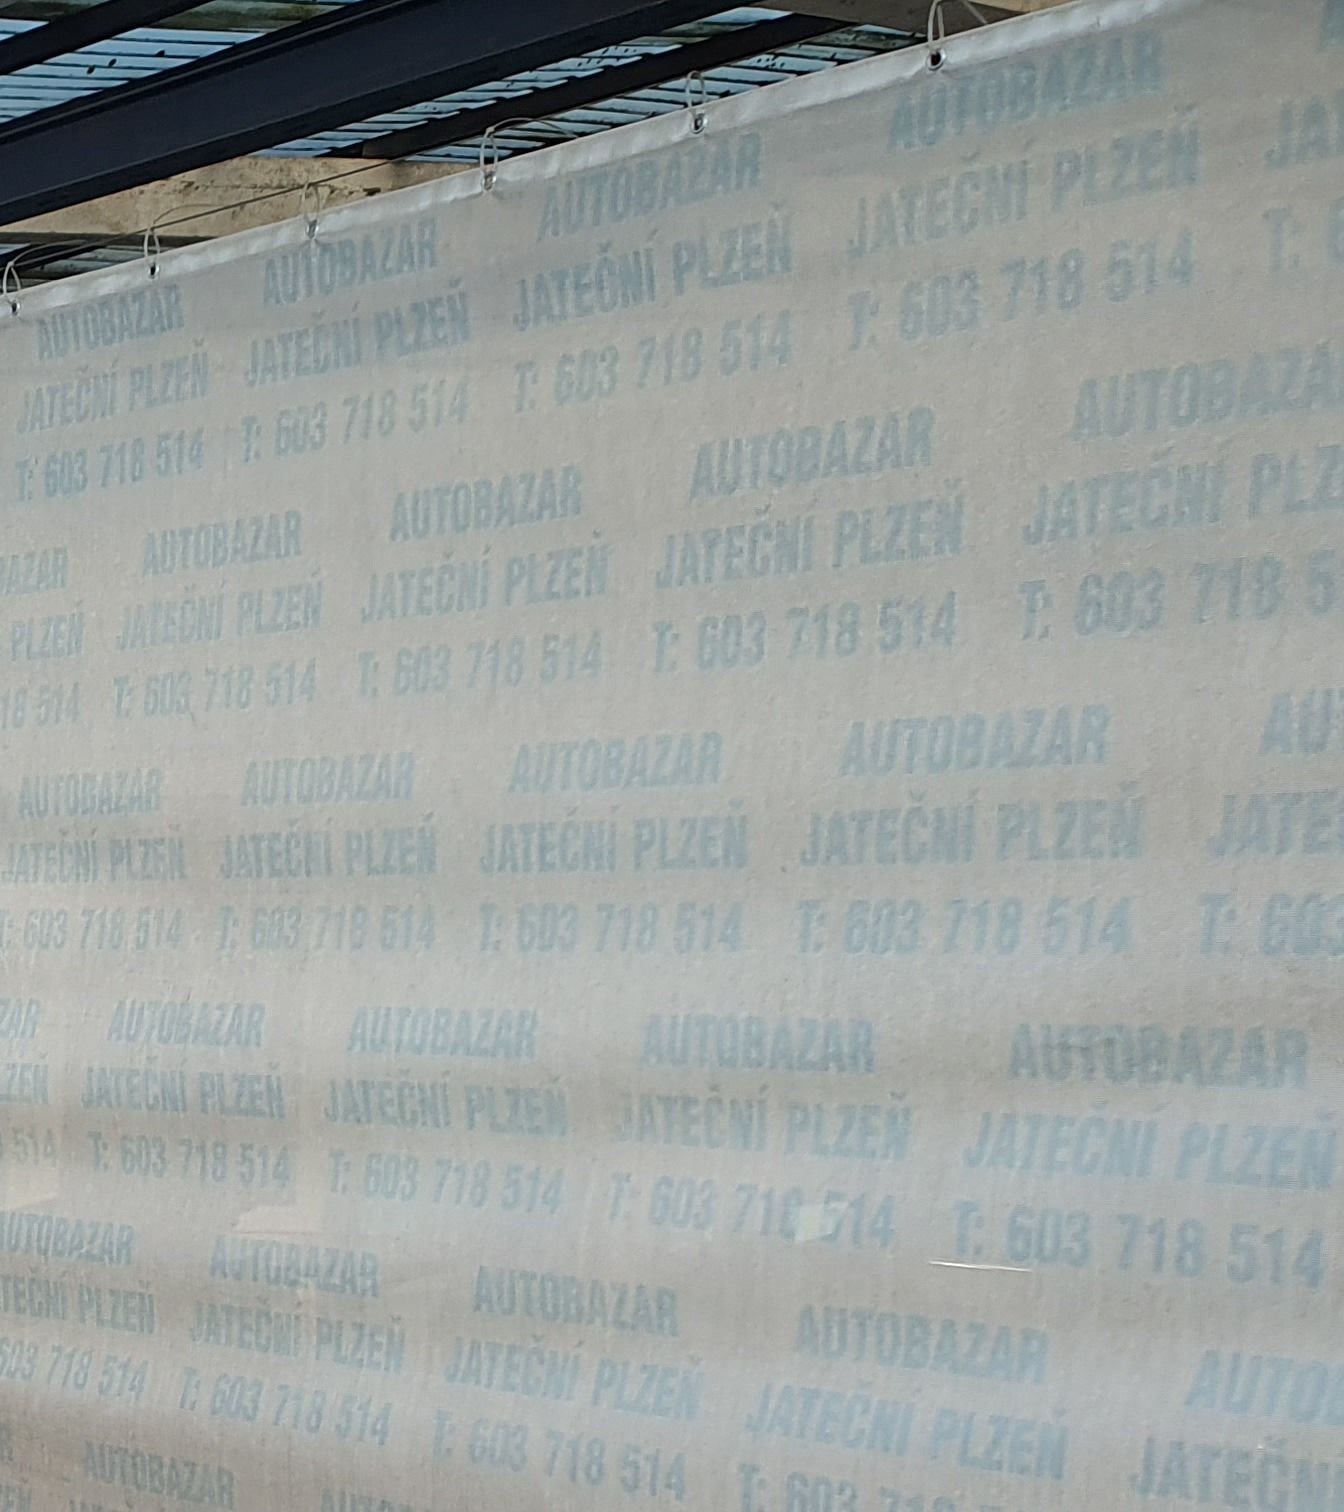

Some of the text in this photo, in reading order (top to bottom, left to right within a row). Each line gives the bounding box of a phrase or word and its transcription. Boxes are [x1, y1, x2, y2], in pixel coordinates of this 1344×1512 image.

[884, 31, 1167, 155] AUTOBAZAR
[537, 134, 761, 238] AUTOBAZAR
[1051, 104, 1202, 213] PLZEŇ
[258, 218, 439, 307] AUTOBAZAR
[673, 202, 792, 295] PLZEŇ
[33, 283, 184, 361] AUTOBAZAR
[373, 278, 470, 359] PLZEŇ
[128, 339, 209, 412] PLZEŇ
[688, 409, 934, 497] AUTOBAZAR
[386, 465, 585, 542] AUTOBAZAR
[833, 479, 965, 566] PLZEŇ
[139, 510, 303, 577] AUTOBAZAR
[503, 530, 609, 606] PLZEŇ
[11, 600, 83, 662] PLZEŇ
[236, 569, 323, 637] PLZEŇ
[696, 612, 767, 670] 603
[787, 601, 861, 660] 718
[877, 591, 957, 654] 514
[393, 644, 450, 697] 603
[466, 636, 526, 689] 718
[539, 629, 602, 685] 514
[508, 732, 724, 794] AUTOBAZAR
[839, 706, 1109, 776] AUTOBAZAR
[16, 769, 163, 818] AUTOBAZAR
[240, 751, 416, 806] AUTOBAZAR
[108, 824, 187, 881] PLZEŇ
[344, 813, 437, 876] PLZEŇ
[633, 800, 748, 870] PLZEŇ
[997, 782, 1142, 861] PLZEŇ
[516, 903, 579, 953] 603
[595, 902, 659, 953] 718
[673, 902, 743, 954] 514
[844, 899, 922, 955] 603
[943, 896, 1024, 954] 718
[1043, 896, 1130, 955] 514
[107, 1000, 265, 1048] AUTOBAZAR
[347, 1006, 538, 1059] AUTOBAZAR
[639, 1015, 874, 1074] AUTOBAZAR
[1007, 1022, 1306, 1090] AUTOBAZAR
[200, 1062, 283, 1120] PLZEŇ
[465, 1074, 567, 1138] PLZEŇ
[785, 1090, 911, 1161] PLZEŇ
[209, 1235, 379, 1299] AUTOBAZAR
[1006, 1206, 1091, 1268] 603
[1116, 1214, 1205, 1278] 718
[79, 1281, 154, 1335] PLZEŇ
[471, 1266, 679, 1338] AUTOBAZAR
[315, 1315, 405, 1374] PLZEŇ
[791, 1302, 1050, 1385] AUTOBAZAR
[593, 1357, 704, 1423] PLZEŇ
[81, 1439, 233, 1510] AUTOBAZAR
[931, 1409, 1069, 1482] PLZEŇ
